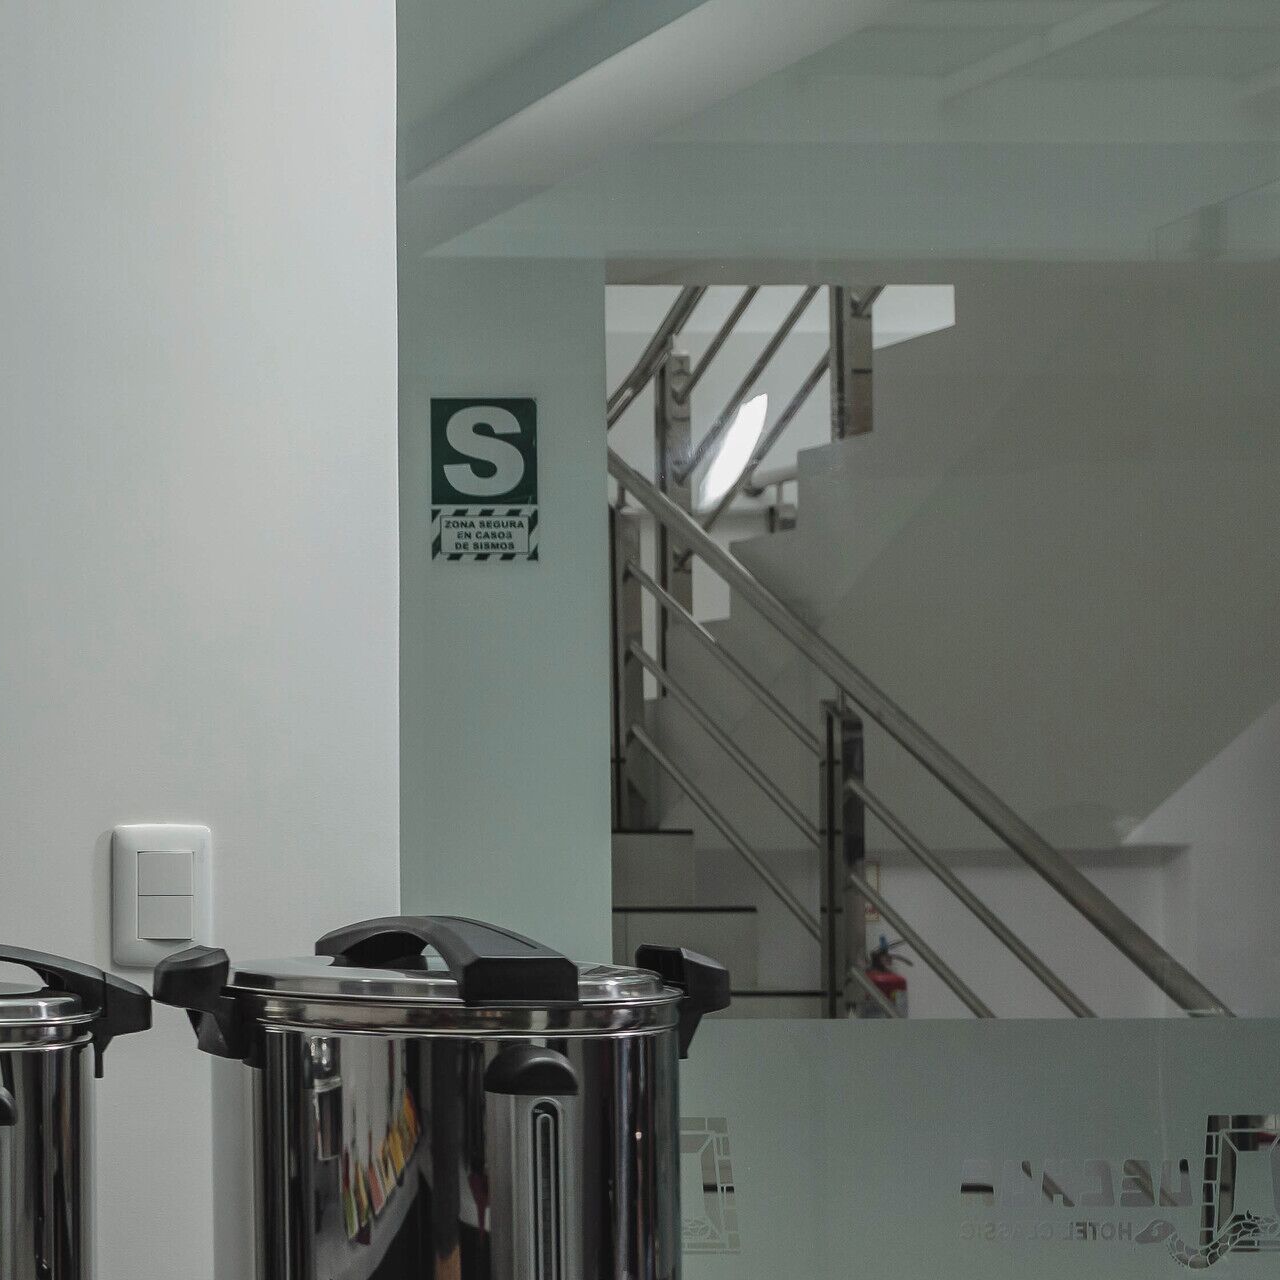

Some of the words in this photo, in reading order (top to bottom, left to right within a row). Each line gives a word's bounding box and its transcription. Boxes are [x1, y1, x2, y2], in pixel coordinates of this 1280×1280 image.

[443, 405, 525, 497] S
[444, 520, 476, 529] ZONA
[479, 520, 524, 529] SEGURA
[457, 531, 472, 539] EN
[475, 531, 513, 539] CASOS
[454, 542, 470, 550] DE
[473, 542, 515, 550] SISMOS
